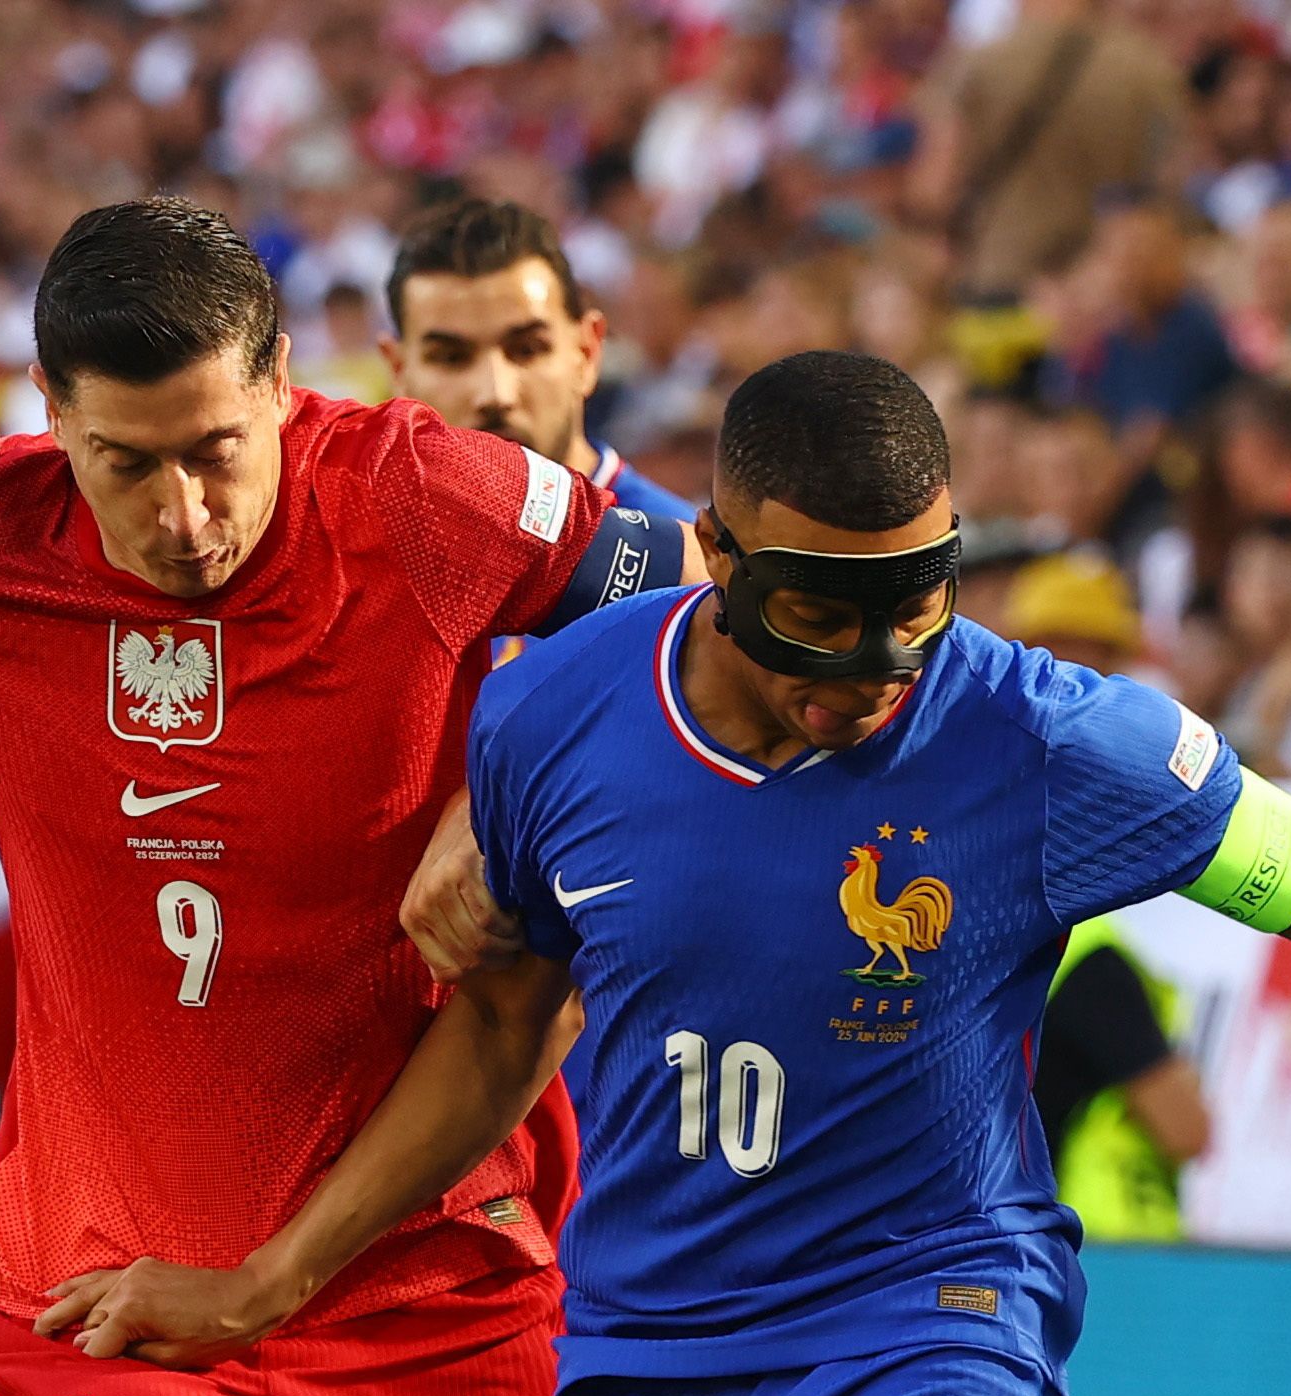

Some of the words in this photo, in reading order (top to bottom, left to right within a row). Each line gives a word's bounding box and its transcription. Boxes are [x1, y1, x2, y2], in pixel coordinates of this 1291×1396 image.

[135, 850, 148, 859] 25
[148, 850, 194, 860] CZERWCA
[195, 852, 220, 860] 2024
[156, 880, 223, 1007] 9
[836, 1029, 853, 1041] 25
[877, 1031, 907, 1043] 2024
[665, 1030, 786, 1179] 10
